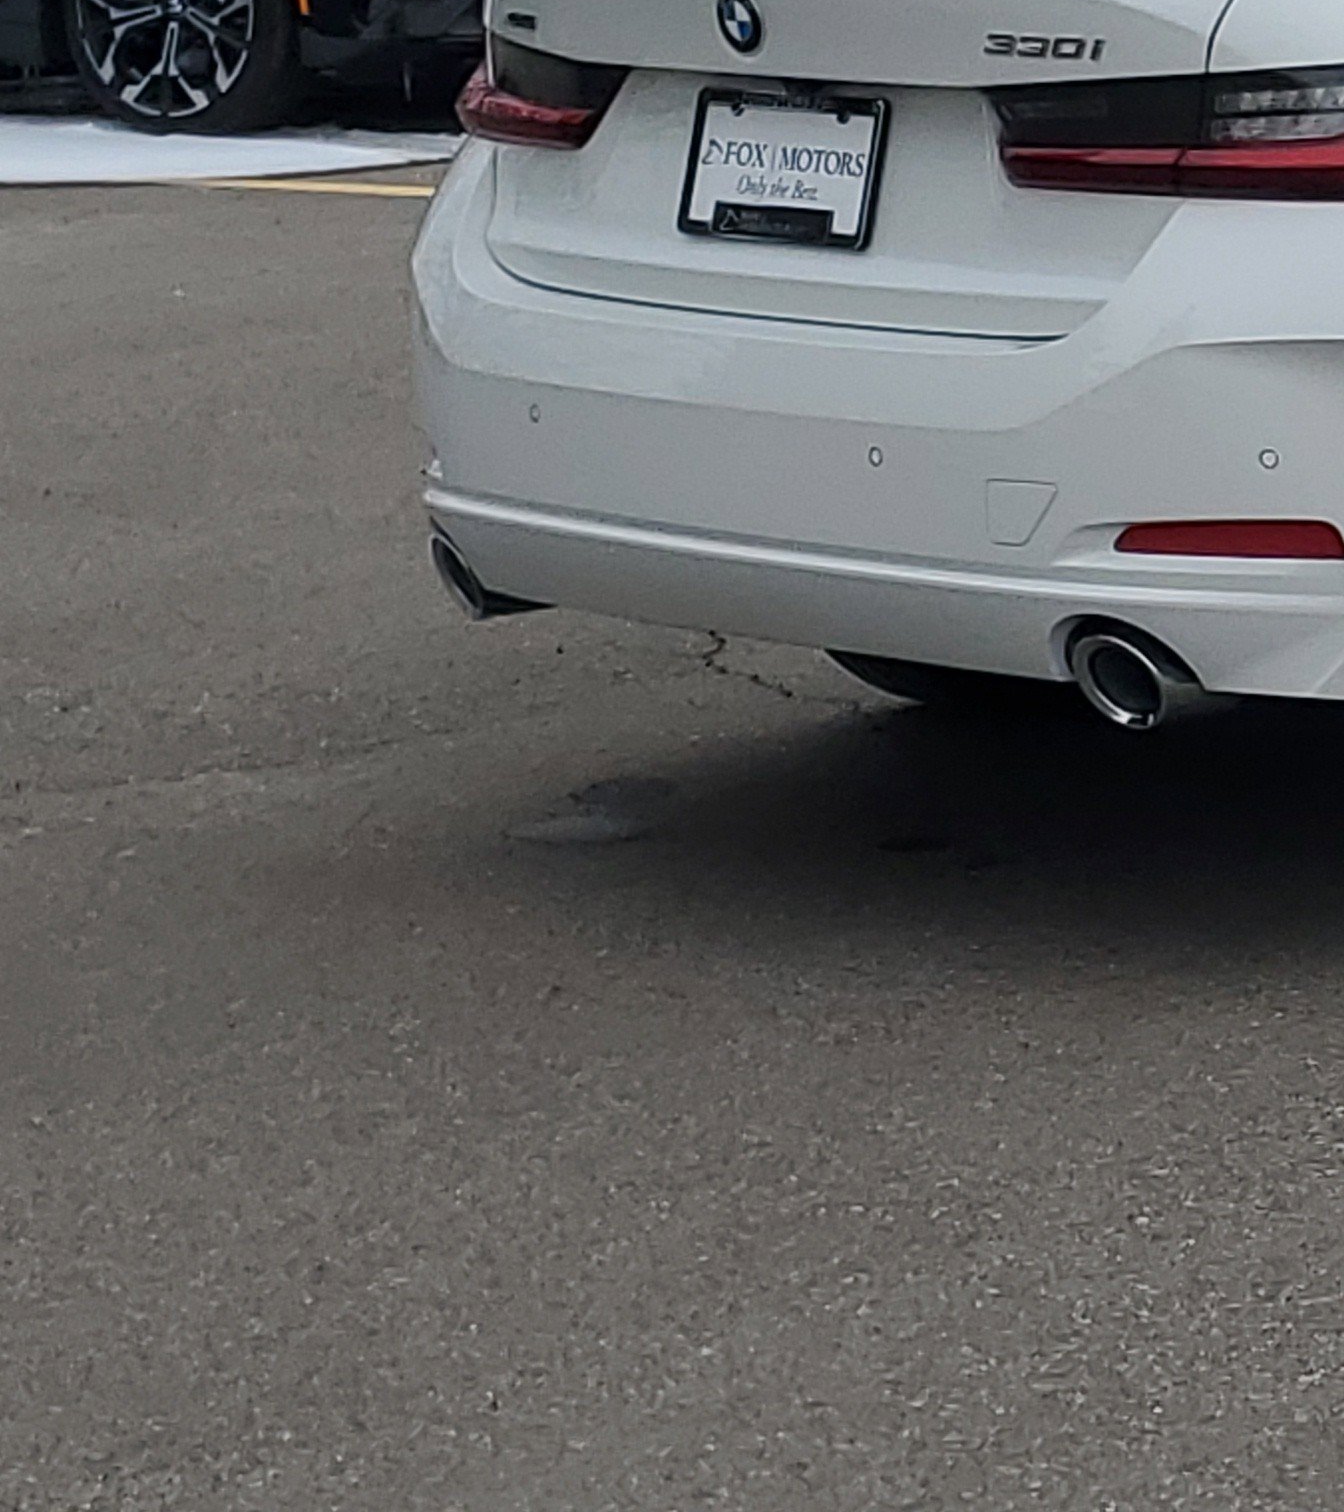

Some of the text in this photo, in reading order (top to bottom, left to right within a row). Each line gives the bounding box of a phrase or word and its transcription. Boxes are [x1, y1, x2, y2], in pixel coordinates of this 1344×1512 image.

[983, 33, 1106, 61] 330i
[722, 140, 866, 178] FOX MOTORS
